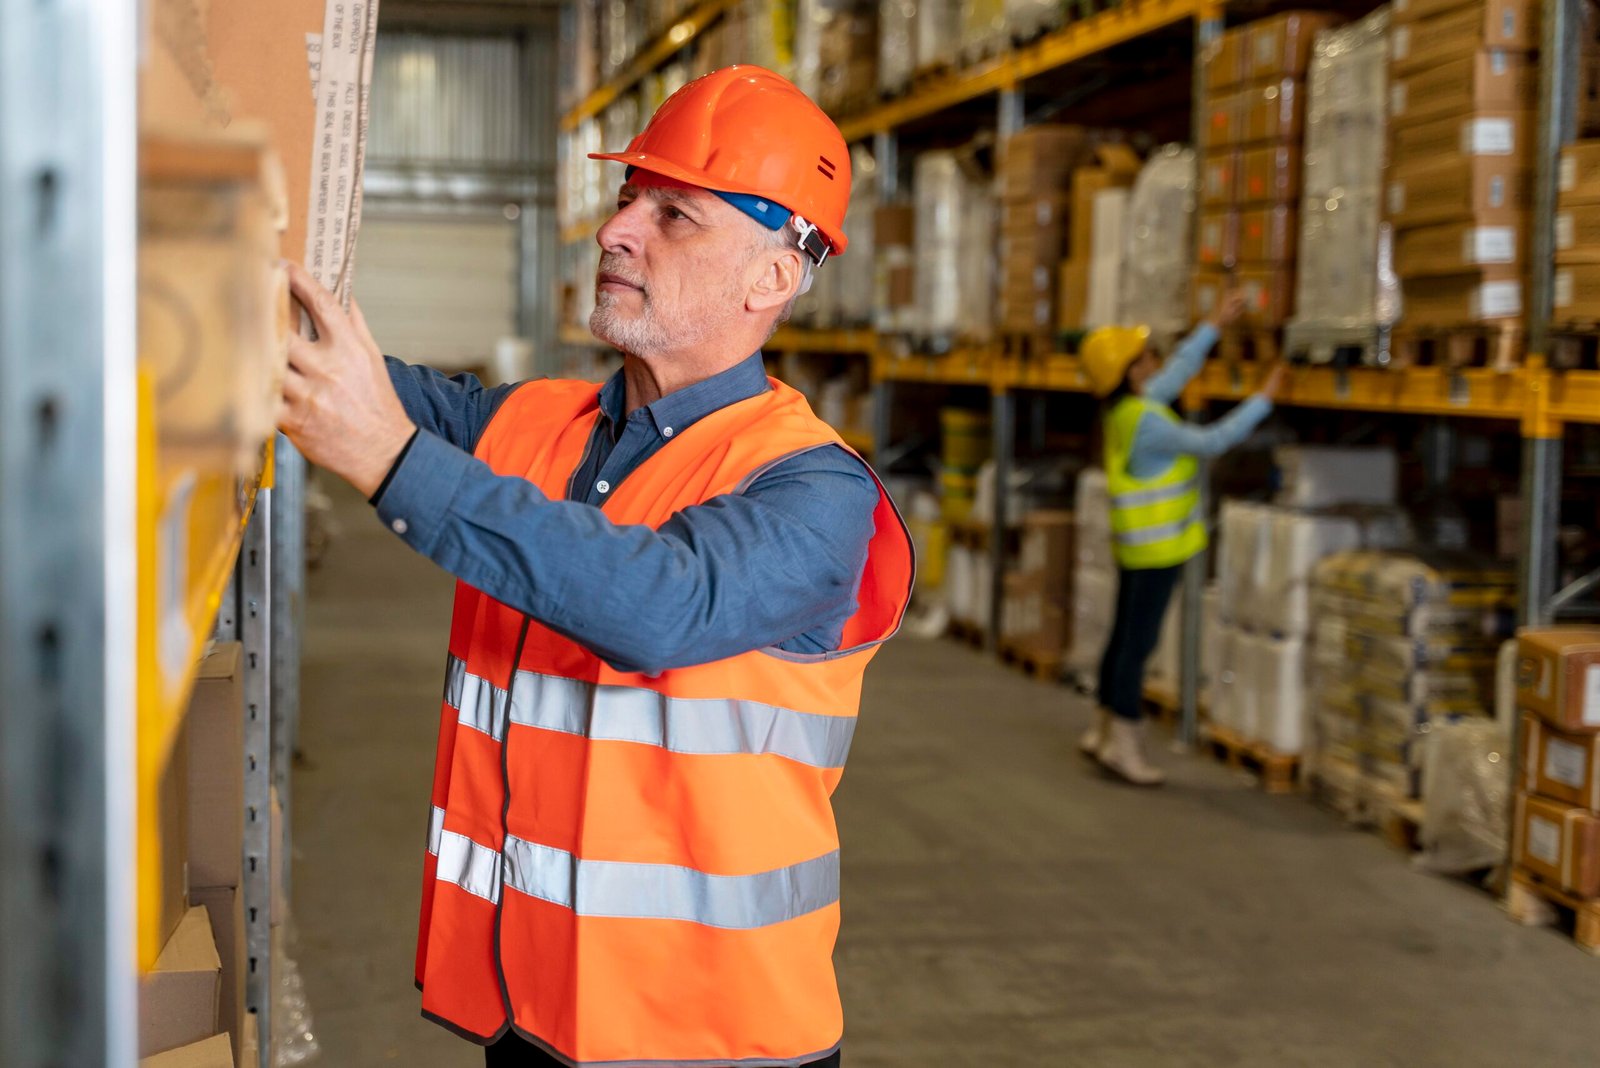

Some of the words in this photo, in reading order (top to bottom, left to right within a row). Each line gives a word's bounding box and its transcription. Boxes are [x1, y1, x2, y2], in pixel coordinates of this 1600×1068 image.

[335, 4, 344, 14] OF
[333, 17, 344, 31] THE
[331, 32, 342, 49] BOX
[327, 91, 337, 108] THIS
[344, 82, 355, 105] FALLS
[324, 111, 335, 129] SEAL
[322, 133, 333, 149] HAS
[321, 152, 331, 172] BEEN
[317, 174, 330, 214] TAMPERED
[313, 239, 325, 268] PLEASE
